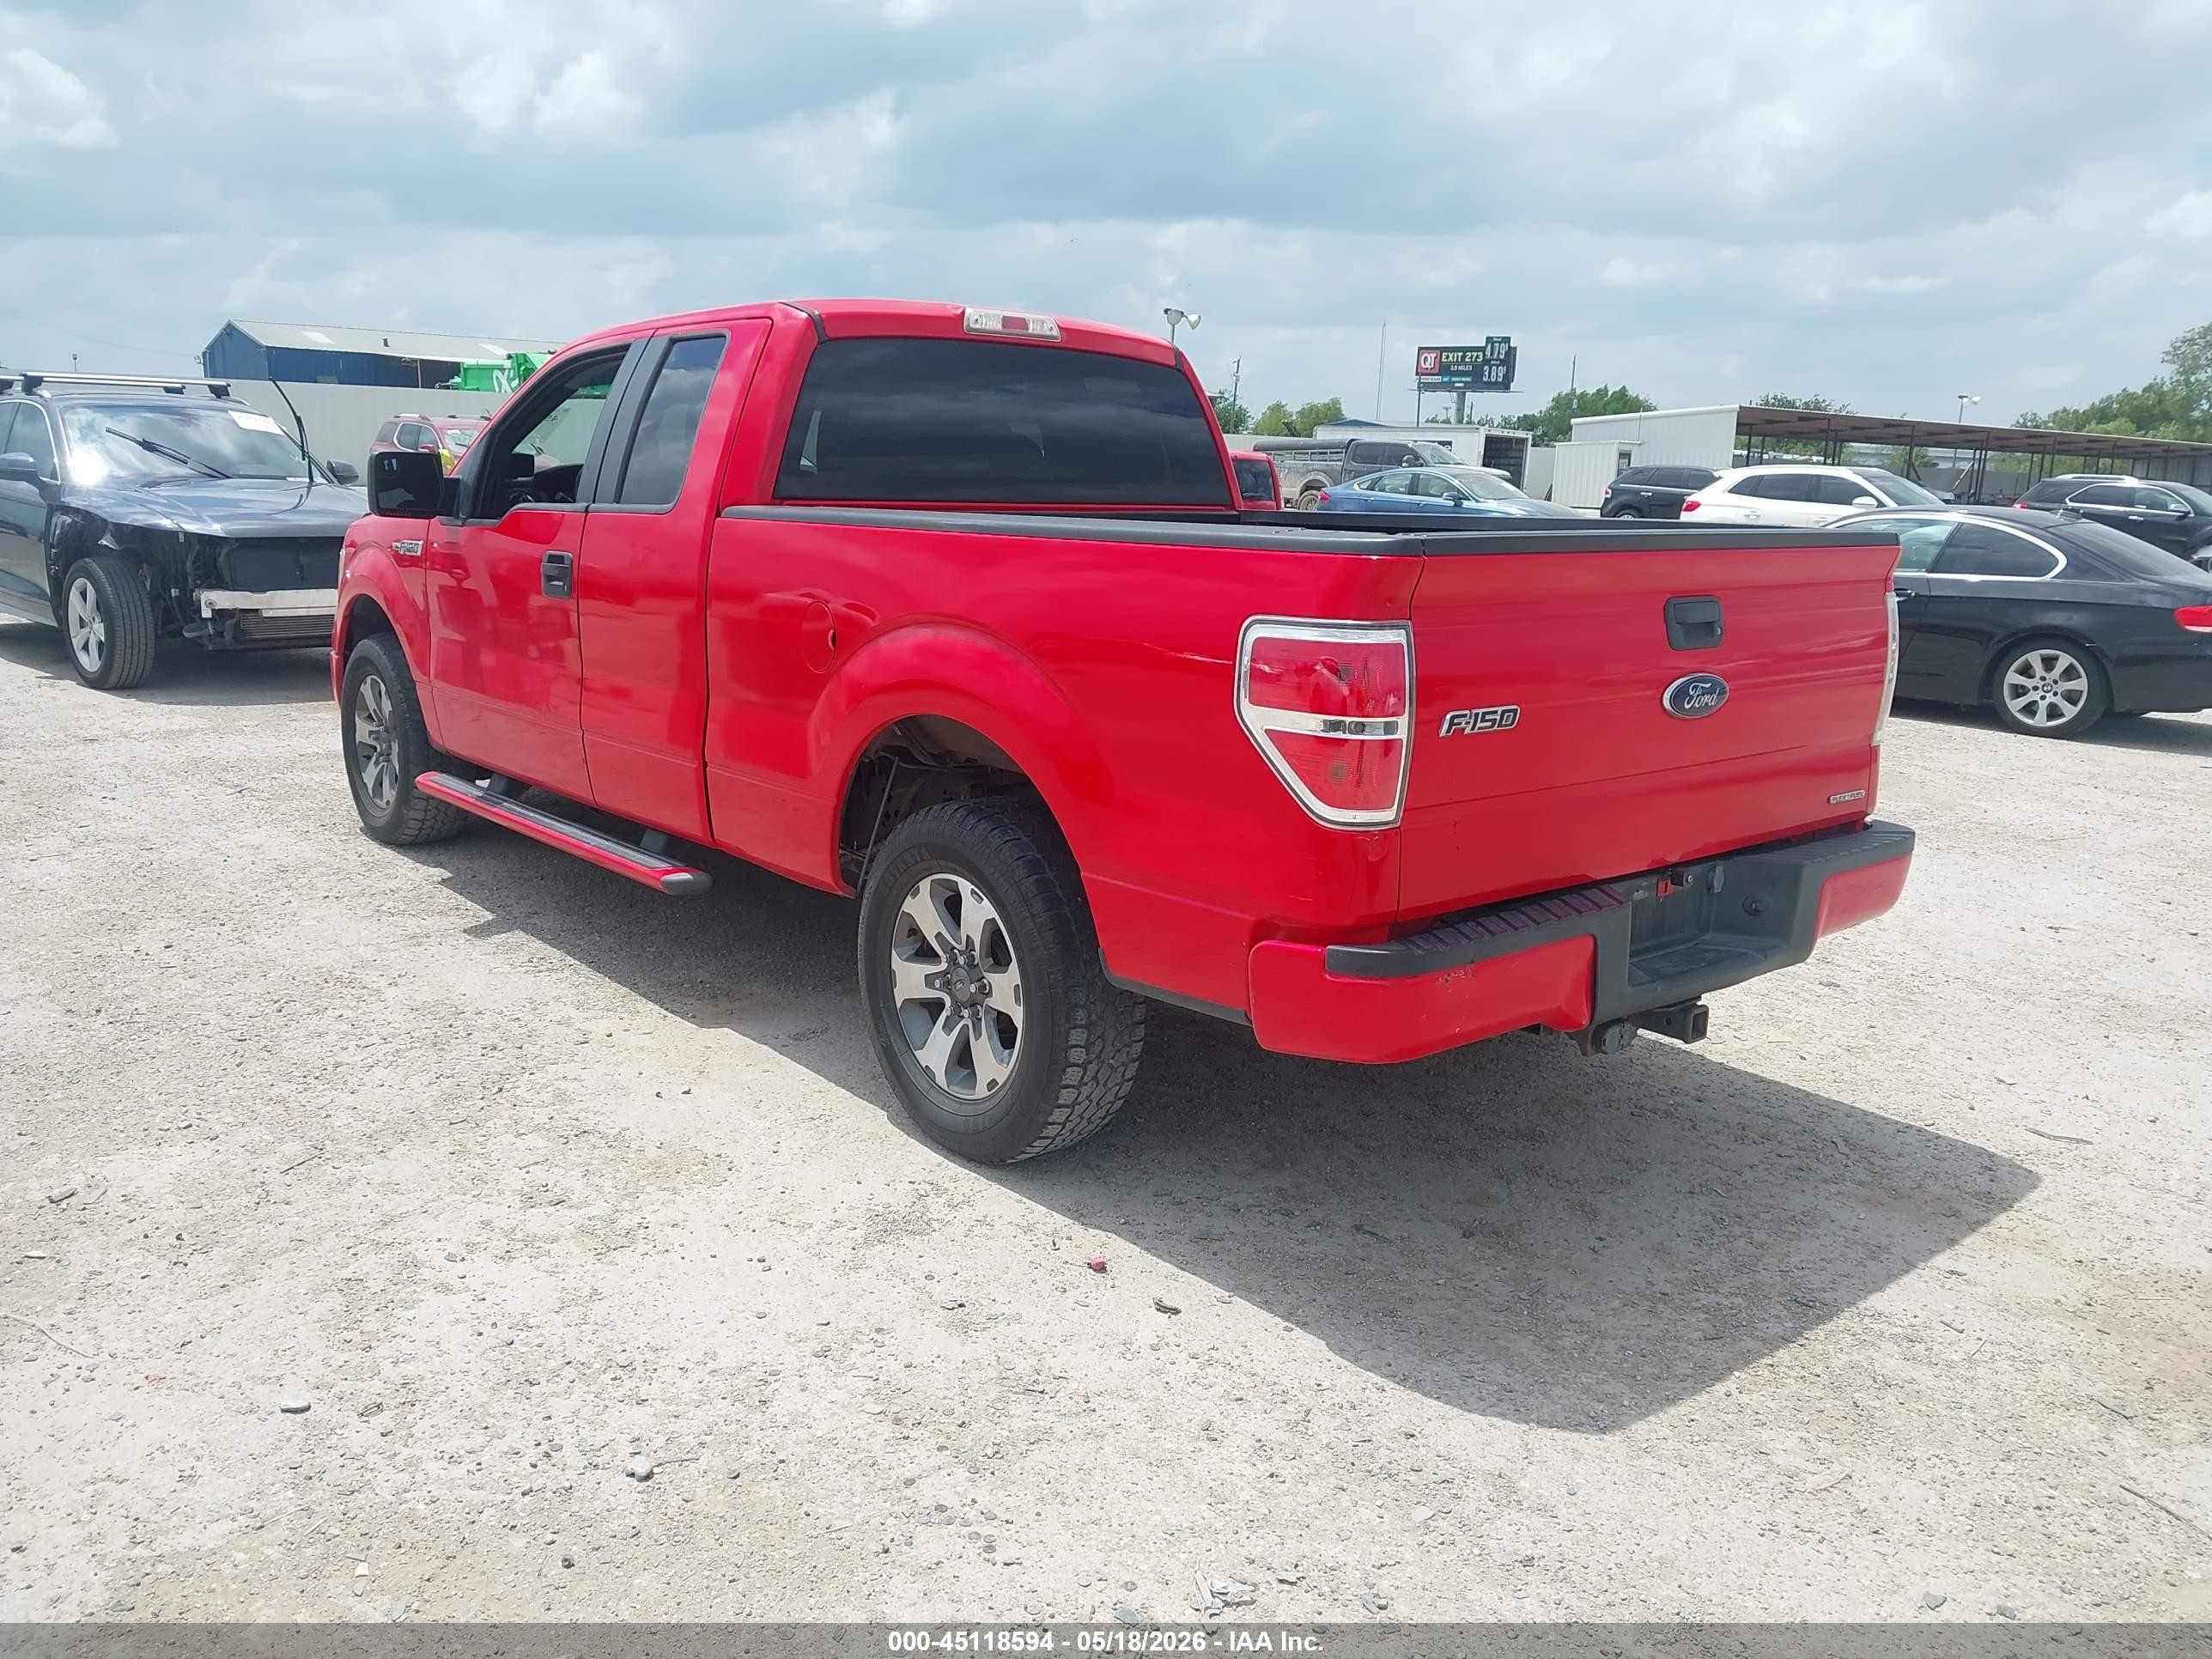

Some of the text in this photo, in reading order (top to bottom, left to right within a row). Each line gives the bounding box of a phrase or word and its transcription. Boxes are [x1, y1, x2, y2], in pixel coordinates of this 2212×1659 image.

[1420, 353, 1437, 370] QT
[1442, 351, 1484, 362] EXIT 273
[1684, 683, 1720, 709] Ford
[1439, 705, 1521, 738] F-150
